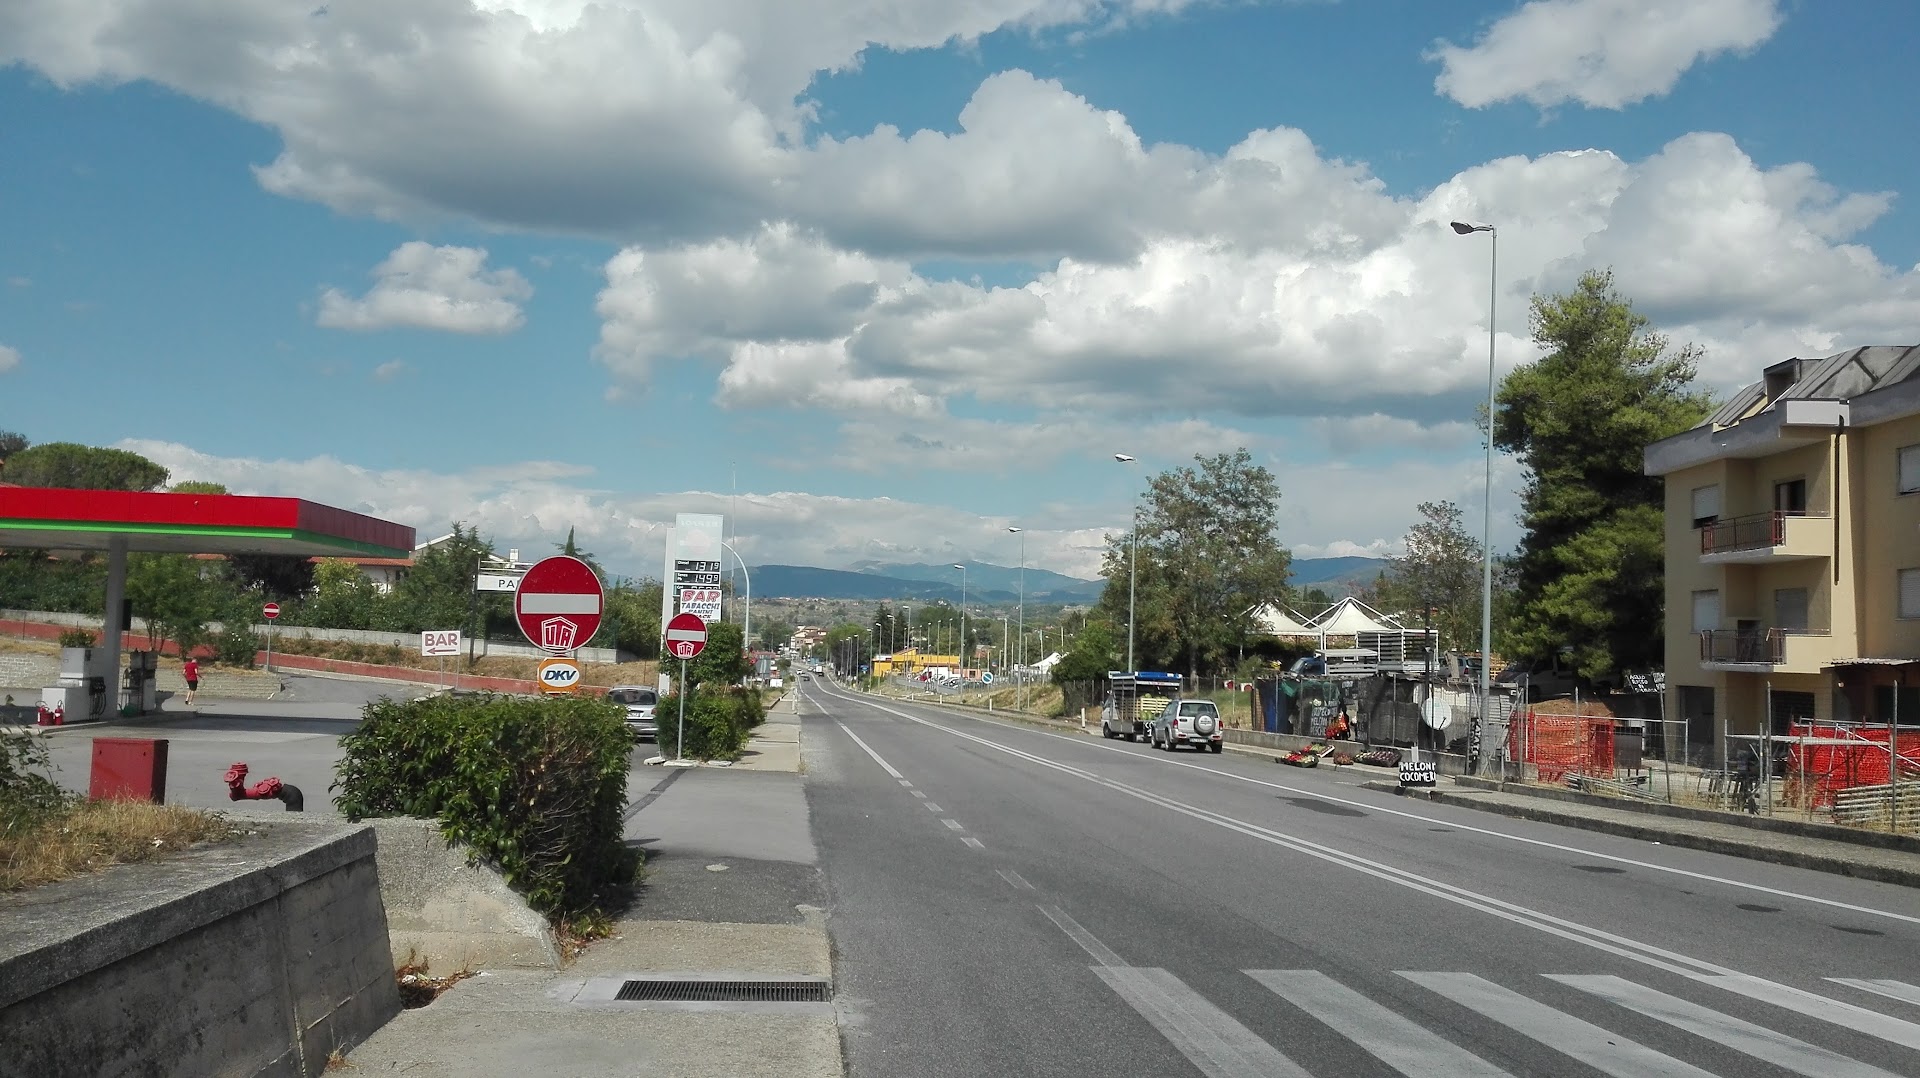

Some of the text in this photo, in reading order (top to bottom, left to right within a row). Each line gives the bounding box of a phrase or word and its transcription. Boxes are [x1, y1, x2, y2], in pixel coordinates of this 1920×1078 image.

[498, 580, 515, 588] PA
[682, 590, 721, 602] BAR
[542, 616, 577, 650] UTA
[424, 632, 458, 646] BAR
[544, 670, 577, 680] DKV
[1399, 761, 1436, 771] MELONI
